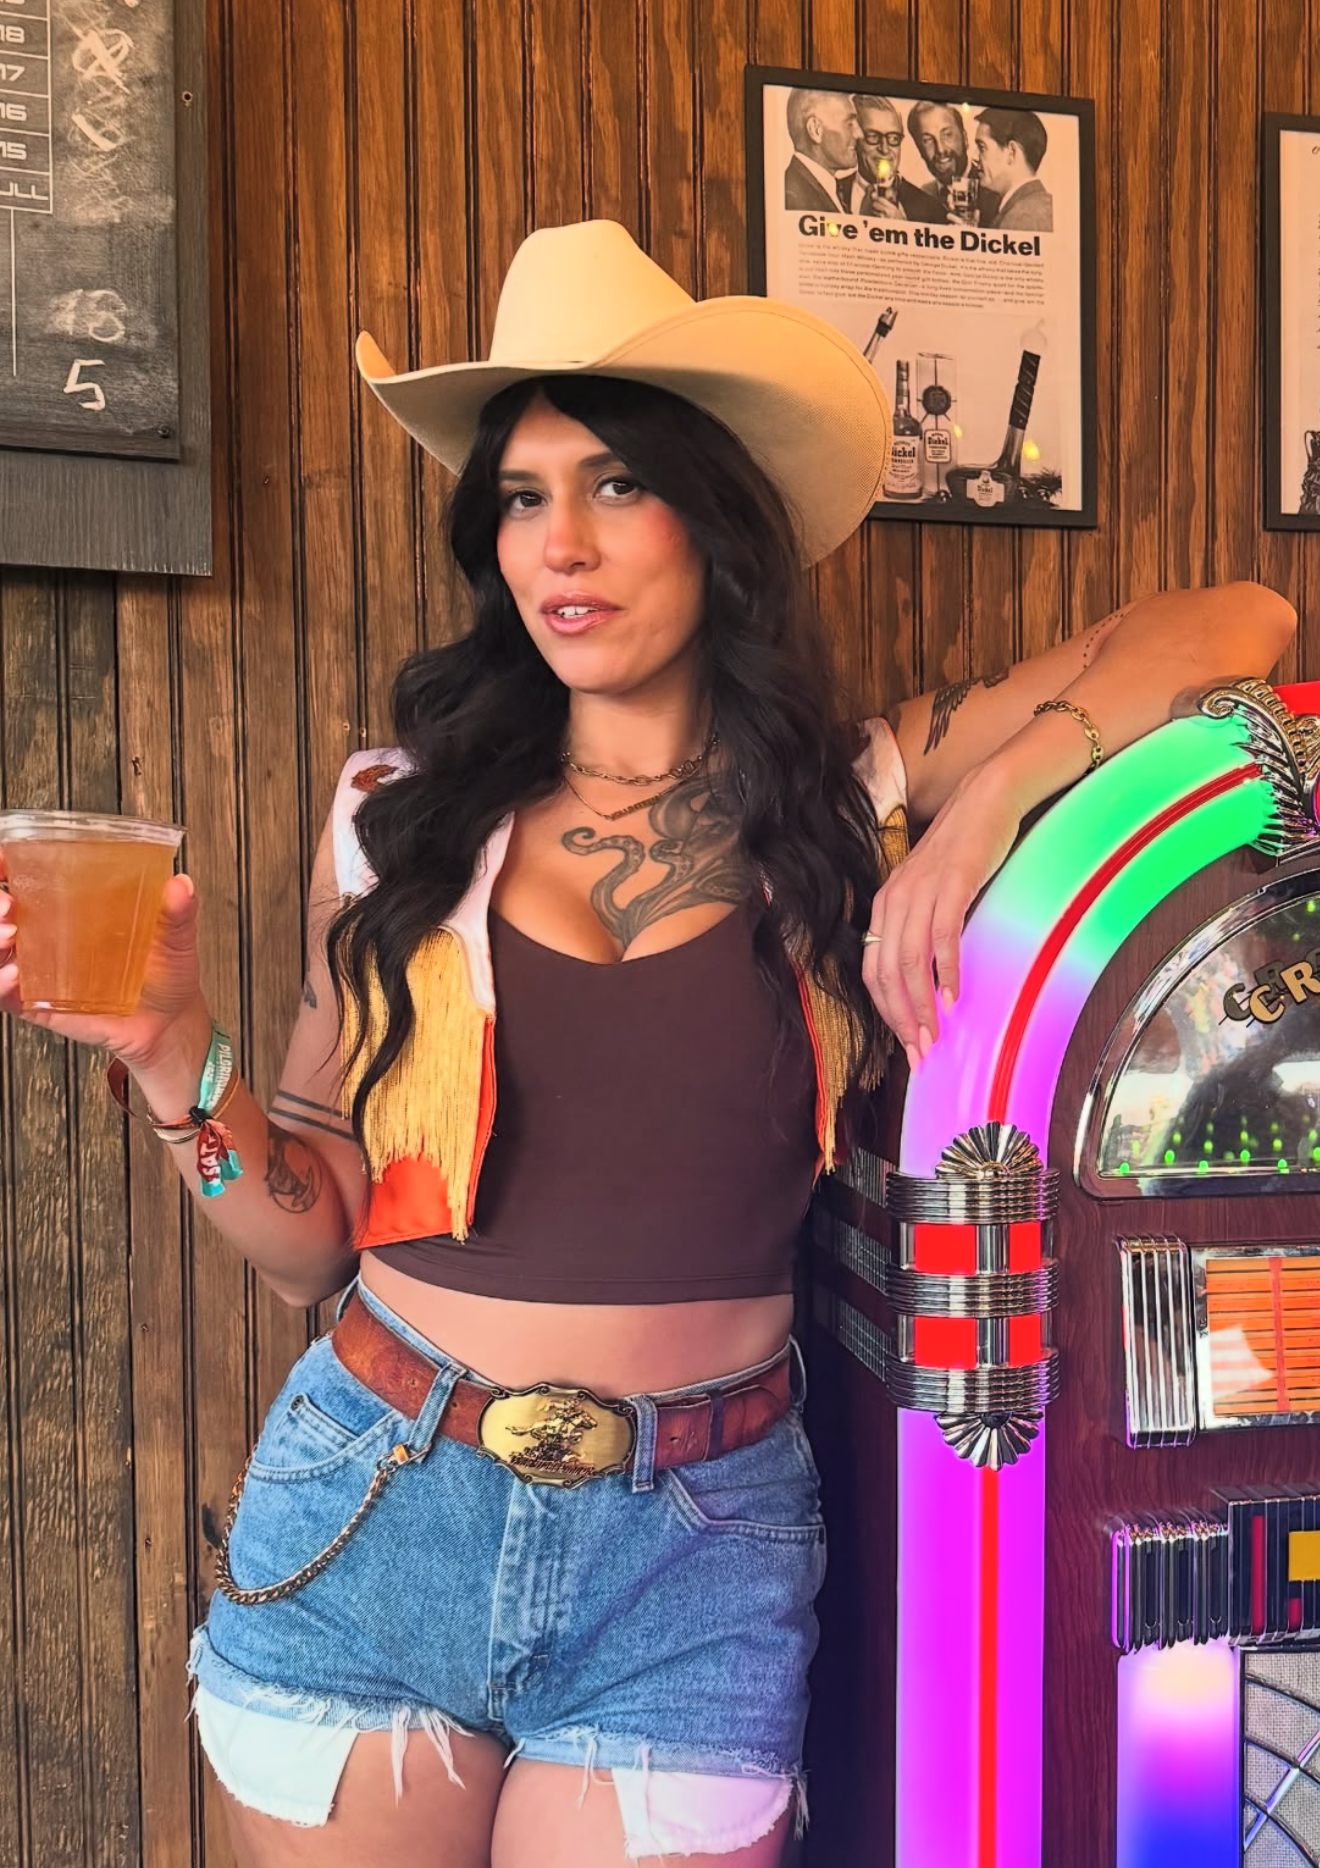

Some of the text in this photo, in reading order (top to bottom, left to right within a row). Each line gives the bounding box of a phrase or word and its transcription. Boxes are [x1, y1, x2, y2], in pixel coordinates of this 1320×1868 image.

[798, 214, 858, 239] Give
[863, 219, 908, 246] 'em
[913, 227, 955, 250] the
[960, 230, 1041, 257] Dickel
[63, 359, 106, 411] 5
